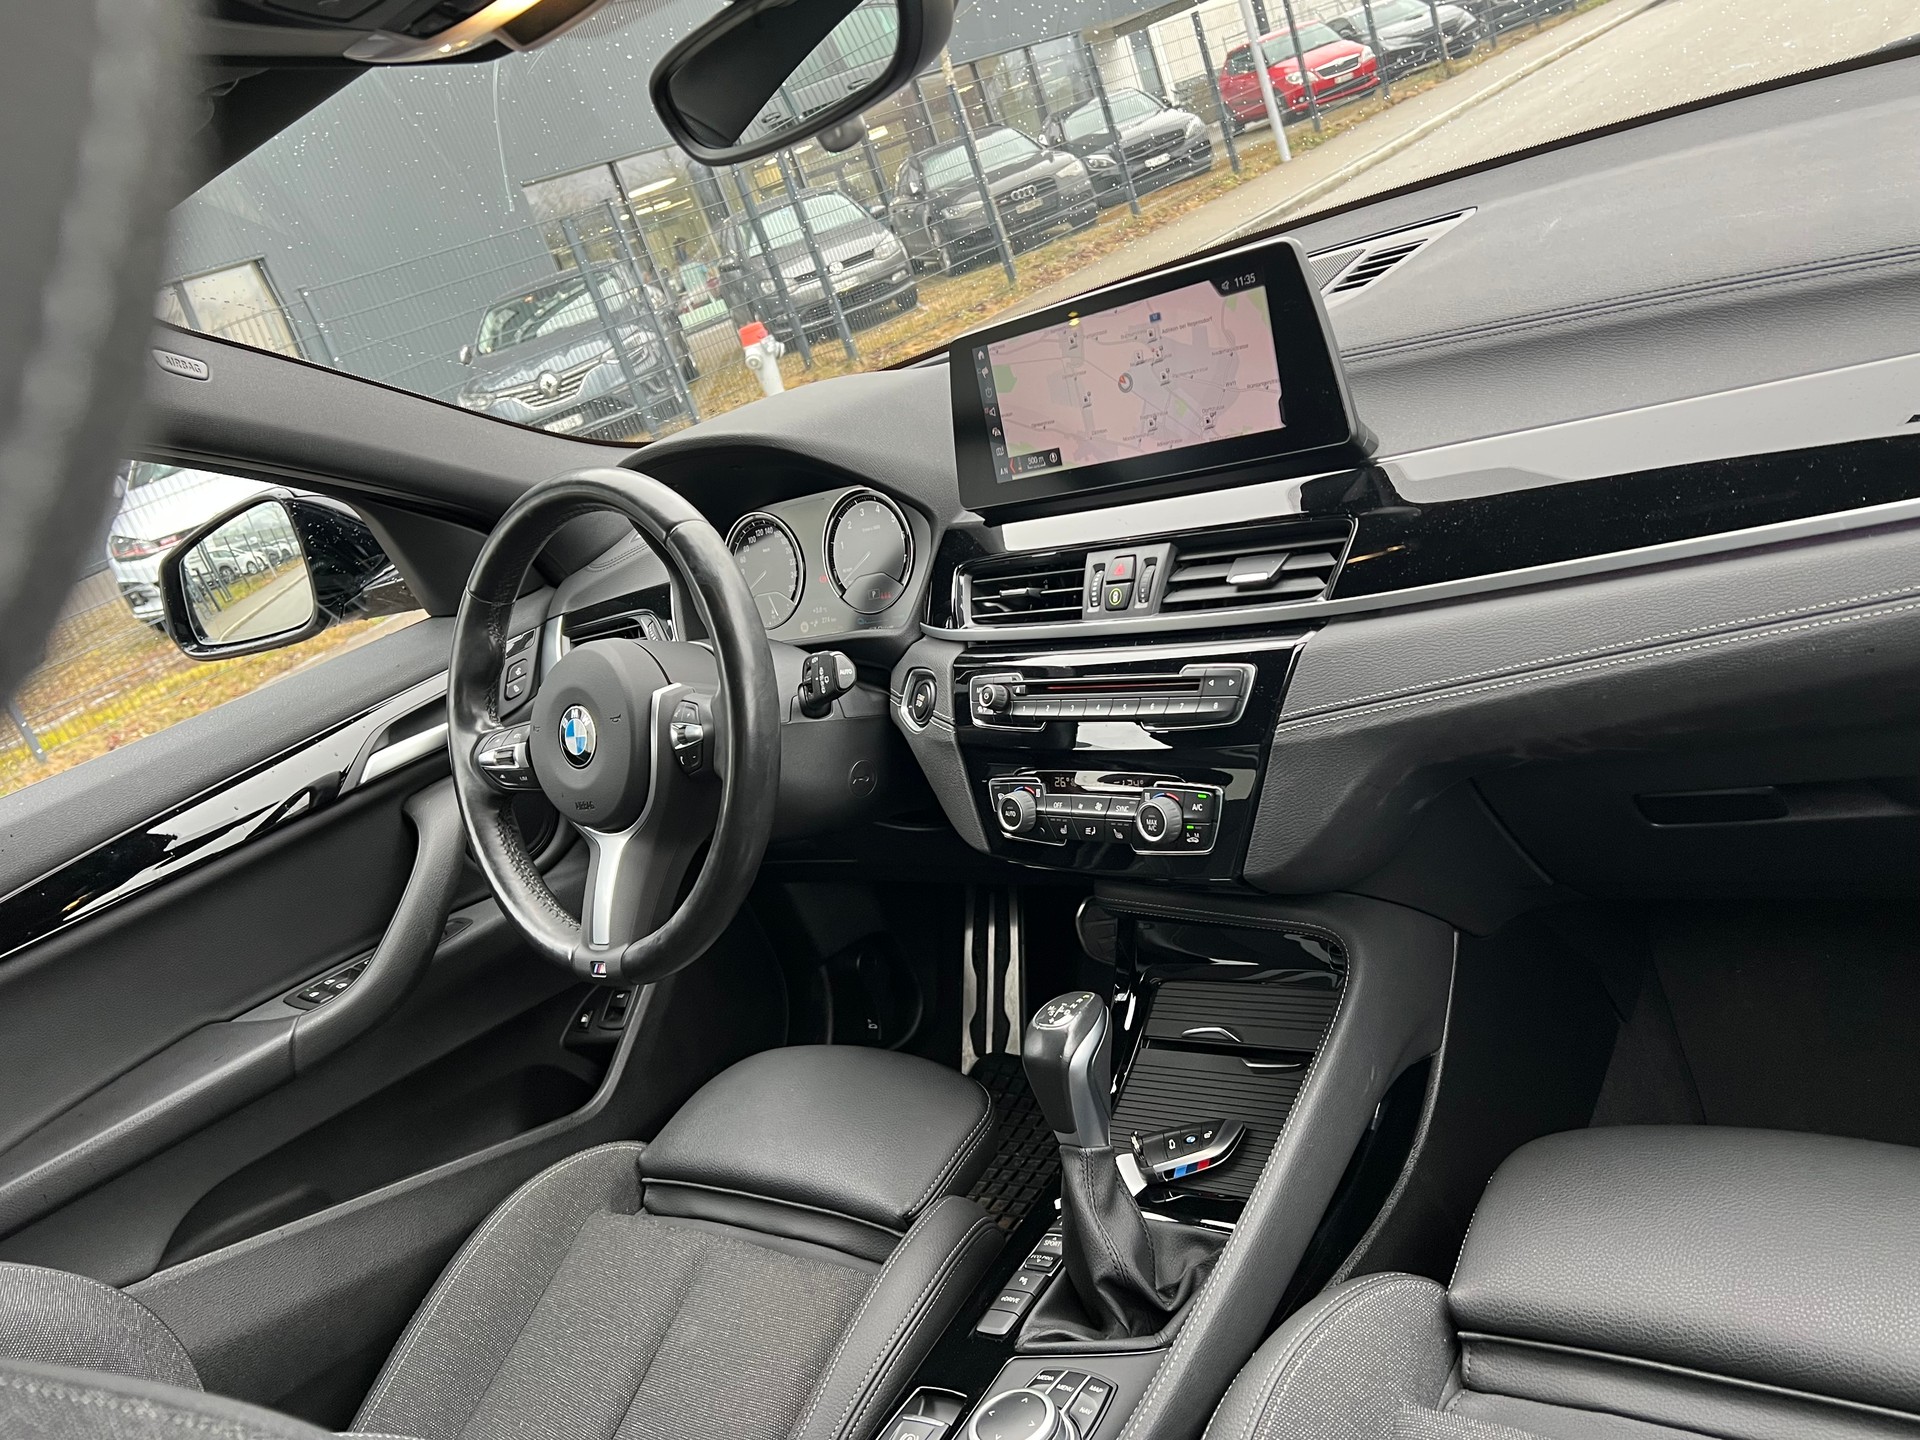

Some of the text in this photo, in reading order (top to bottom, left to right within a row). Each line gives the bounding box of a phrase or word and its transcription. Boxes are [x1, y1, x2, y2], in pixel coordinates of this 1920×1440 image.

[1234, 273, 1256, 287] 11:35
[165, 355, 202, 373] AIRBAG
[562, 709, 592, 729] BMW
[1115, 805, 1130, 813] SYNC
[1191, 803, 1203, 811] A/C
[1146, 818, 1158, 826] MAX
[1043, 1240, 1062, 1248] SPORT
[1036, 1374, 1055, 1382] MEDIA
[1056, 1383, 1075, 1393] MENU
[1088, 1384, 1104, 1393] MAP
[1078, 1406, 1093, 1416] NAV
